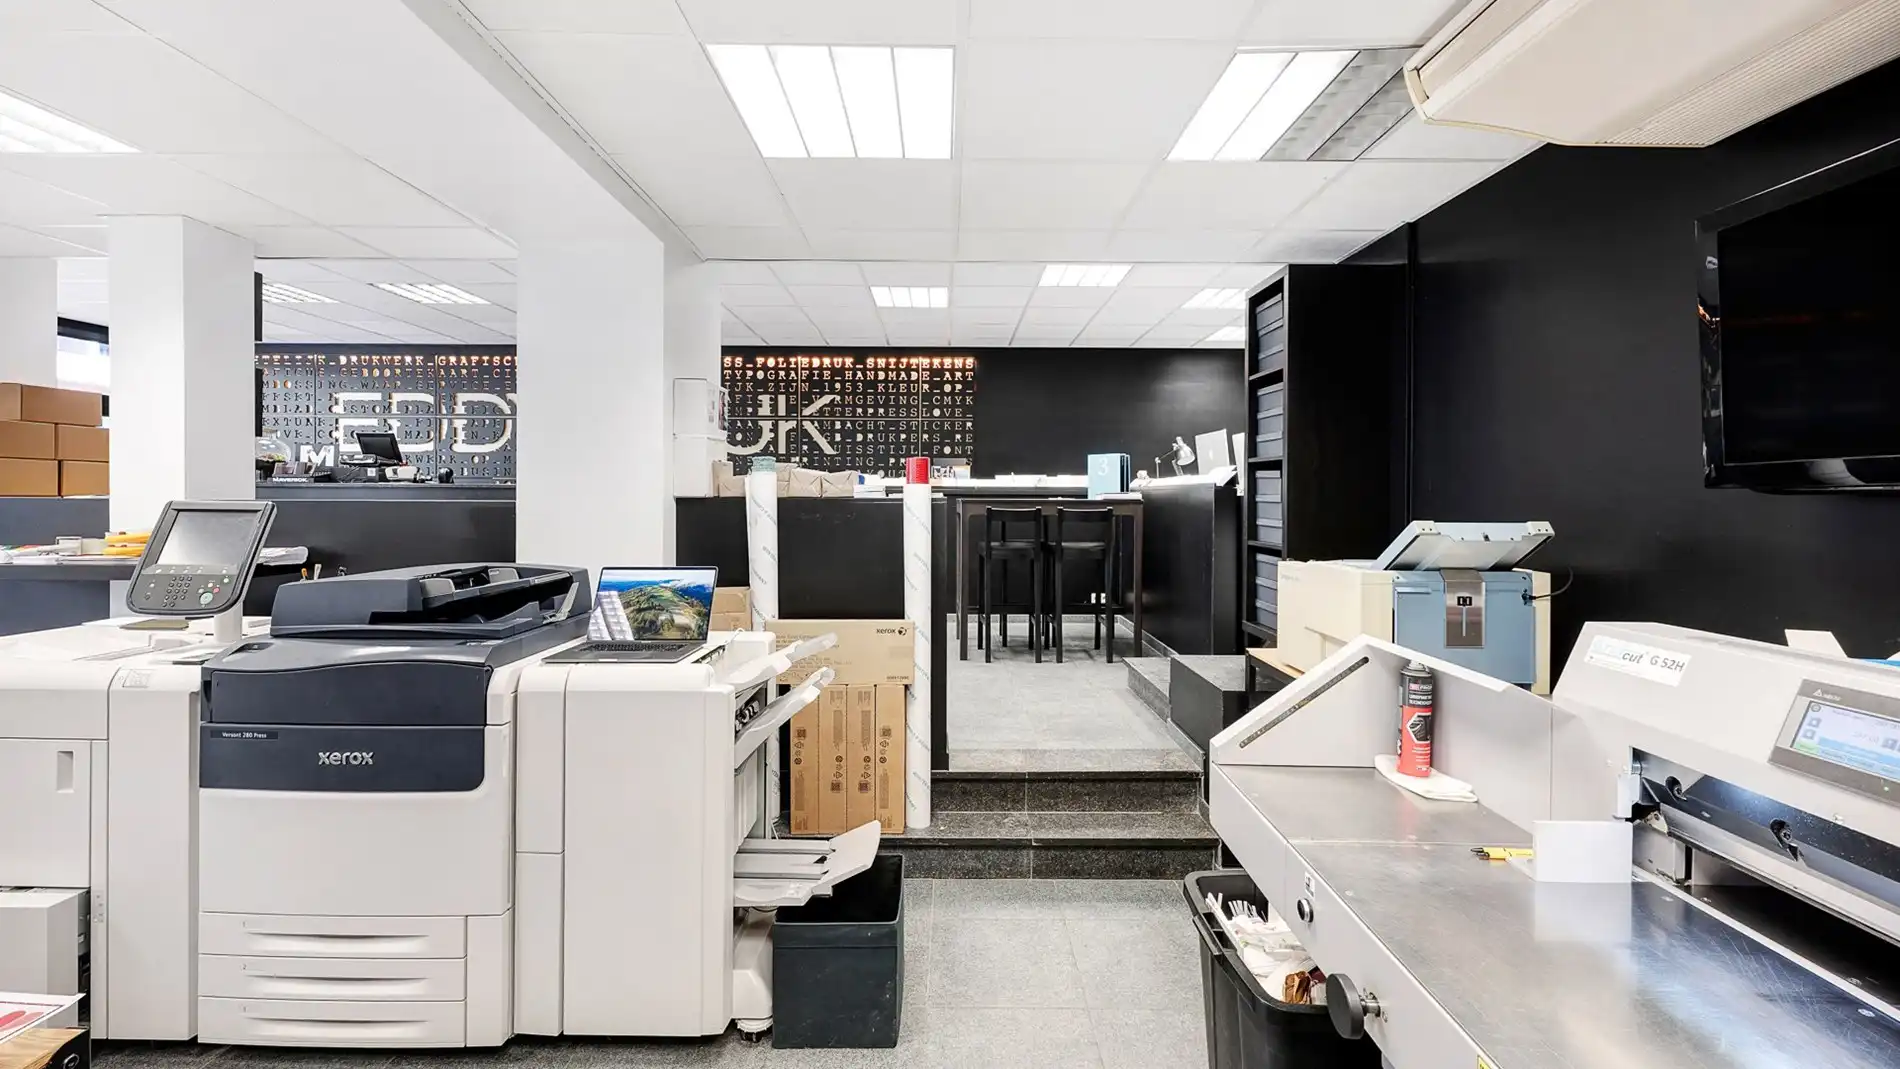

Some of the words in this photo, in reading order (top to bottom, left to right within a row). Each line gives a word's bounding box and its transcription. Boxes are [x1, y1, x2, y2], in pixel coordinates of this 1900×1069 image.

[1098, 459, 1109, 476] 3
[876, 627, 897, 635] xerox
[1660, 657, 1685, 672] 52H
[318, 751, 373, 765] xerox
